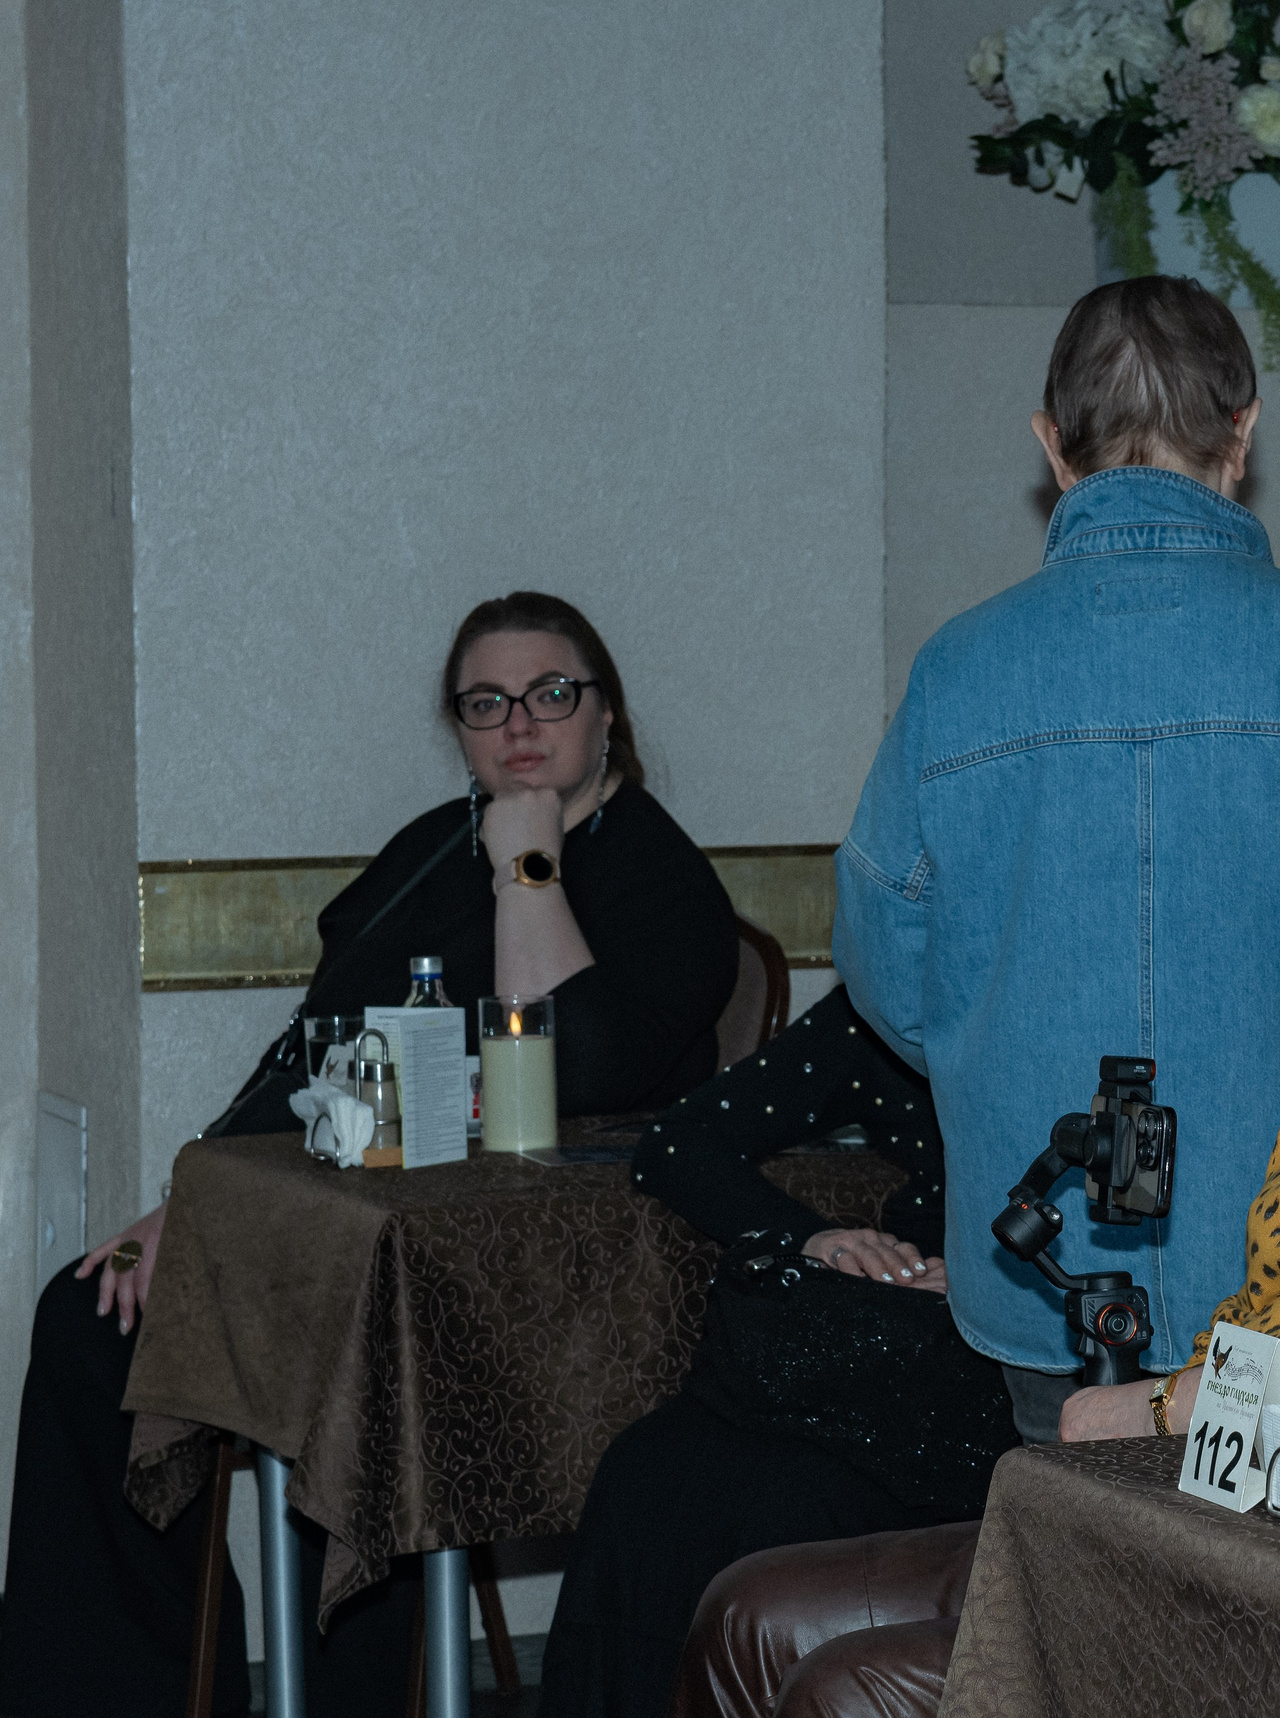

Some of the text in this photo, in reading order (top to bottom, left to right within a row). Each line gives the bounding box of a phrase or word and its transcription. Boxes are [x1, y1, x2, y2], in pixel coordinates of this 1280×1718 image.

[1206, 1380, 1259, 1408] ГНЕЗДО ГЛУХАРЯ
[1193, 1420, 1244, 1494] 112
